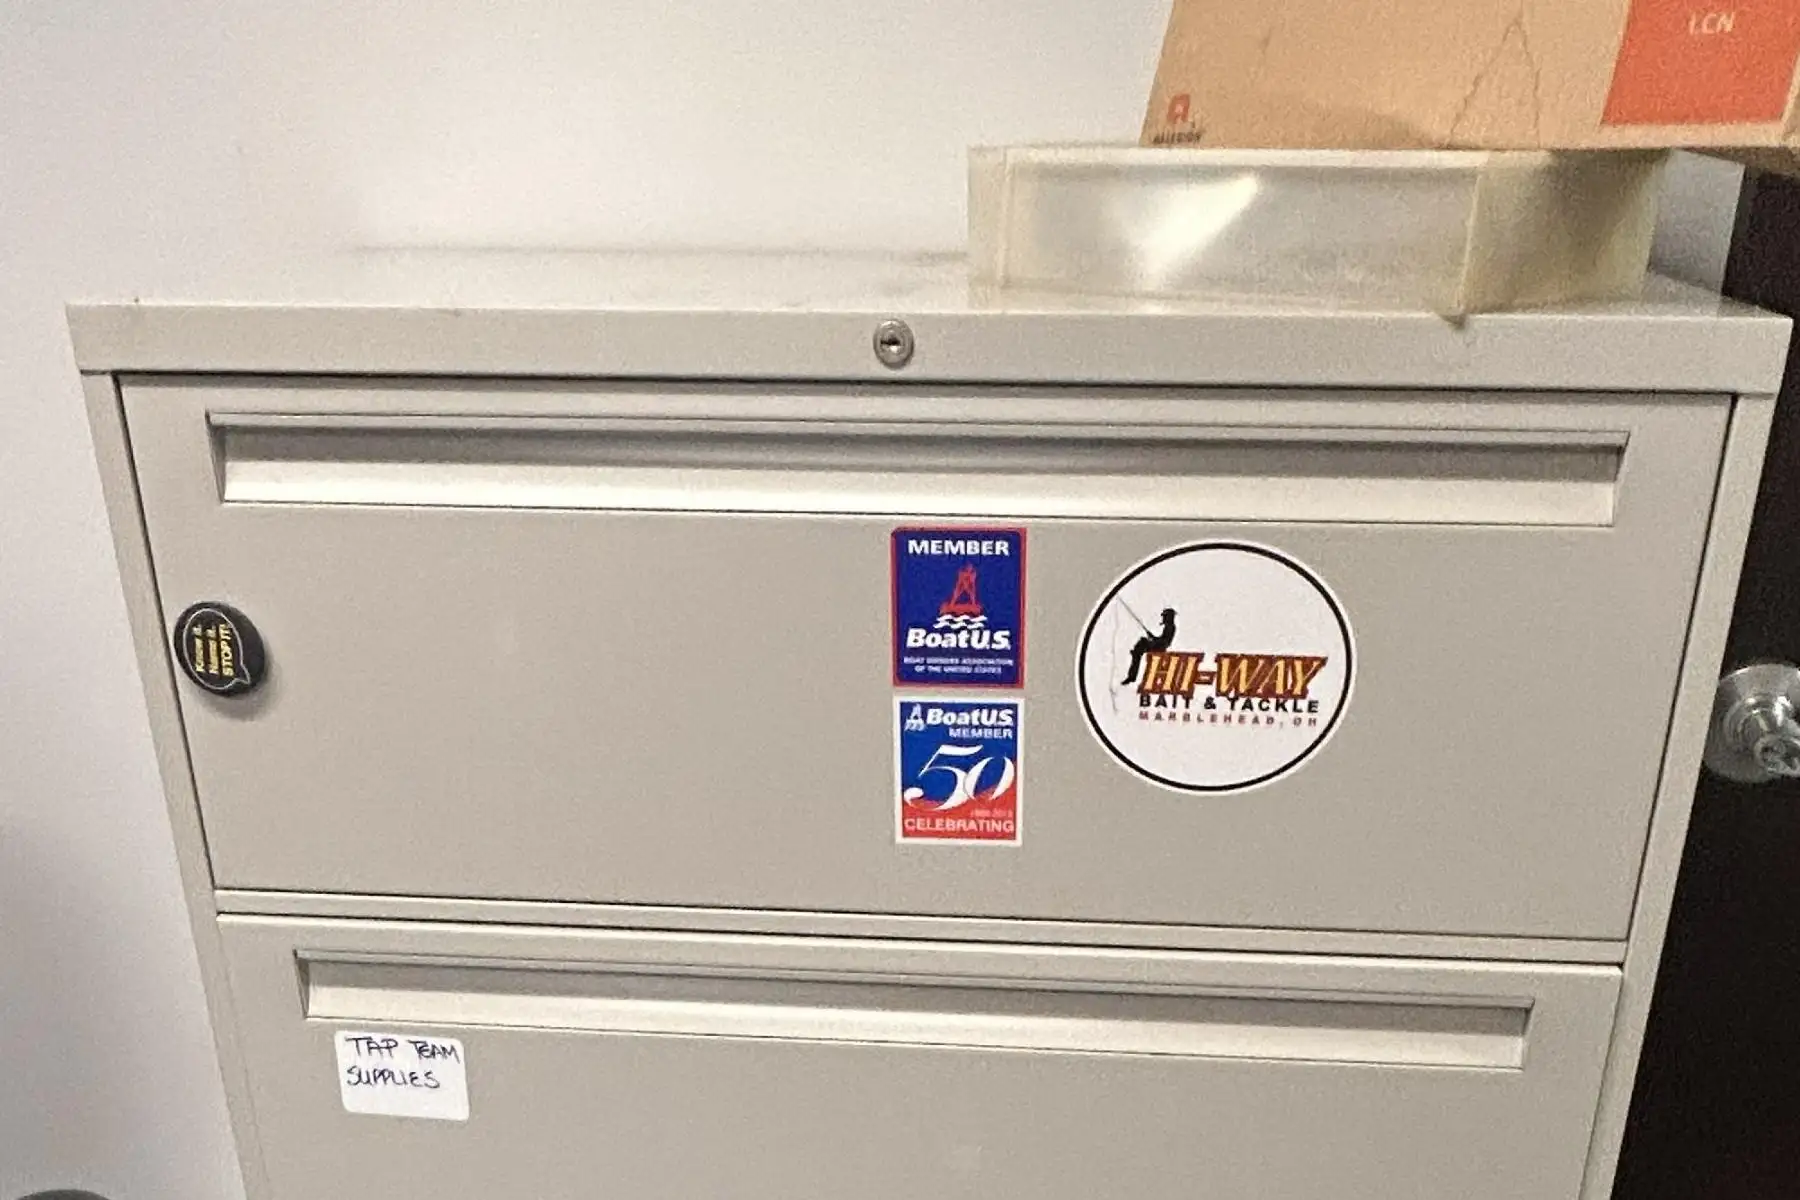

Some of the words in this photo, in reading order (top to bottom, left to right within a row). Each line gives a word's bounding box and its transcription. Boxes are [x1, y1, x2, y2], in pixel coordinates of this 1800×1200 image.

[907, 538, 1010, 556] MEMBER
[1137, 651, 1329, 701] HI-WAY
[1139, 692, 1191, 710] BAIT
[1203, 696, 1217, 710] &
[1225, 696, 1320, 714] TACKLE
[948, 728, 1014, 739] MEMBER
[904, 744, 1014, 811] 50
[904, 818, 1015, 833] CELEBRATING
[345, 1036, 398, 1057] TAP
[346, 1064, 441, 1089] SUPPLIES
